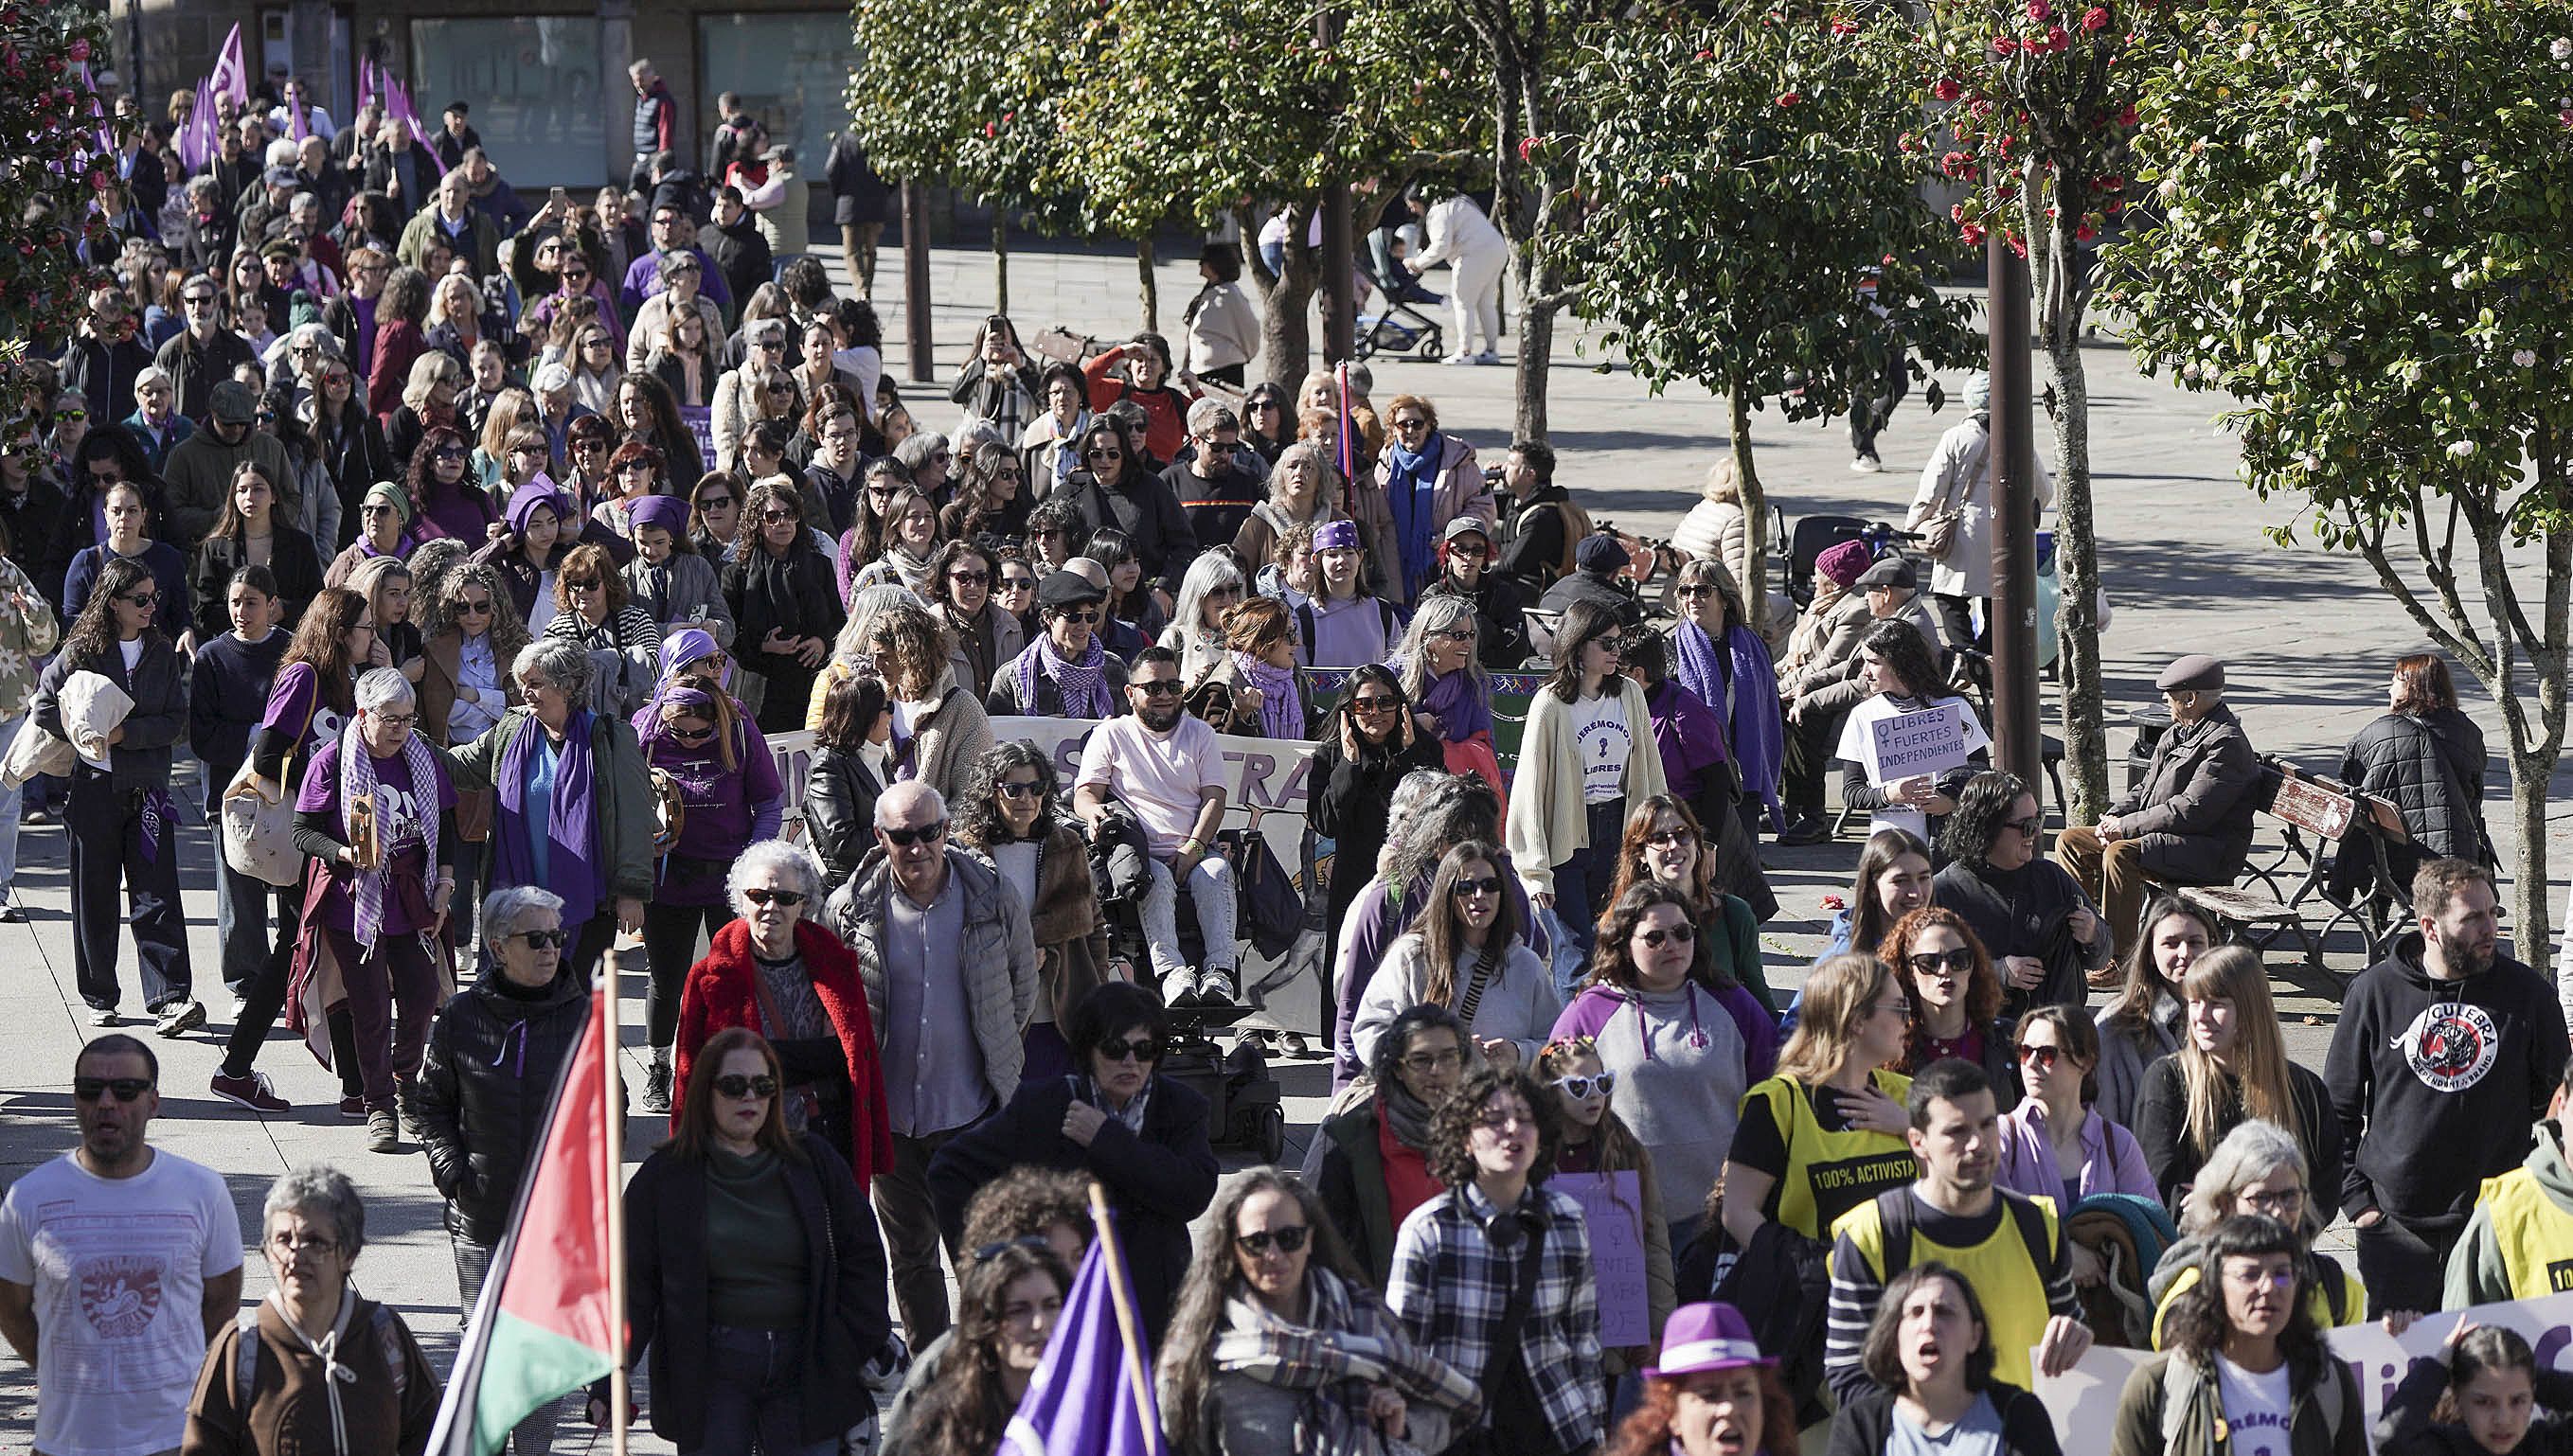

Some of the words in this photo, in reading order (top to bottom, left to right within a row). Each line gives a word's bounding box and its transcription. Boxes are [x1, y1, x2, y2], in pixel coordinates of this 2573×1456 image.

[1894, 726, 1952, 749] FUERTES
[1584, 764, 1621, 775] LIBRES
[2431, 1003, 2496, 1048] CULEBRA
[2468, 1055, 2493, 1083] BRAND
[1814, 1166, 1854, 1190] 100%
[1857, 1159, 1915, 1184] ACTIVISTA
